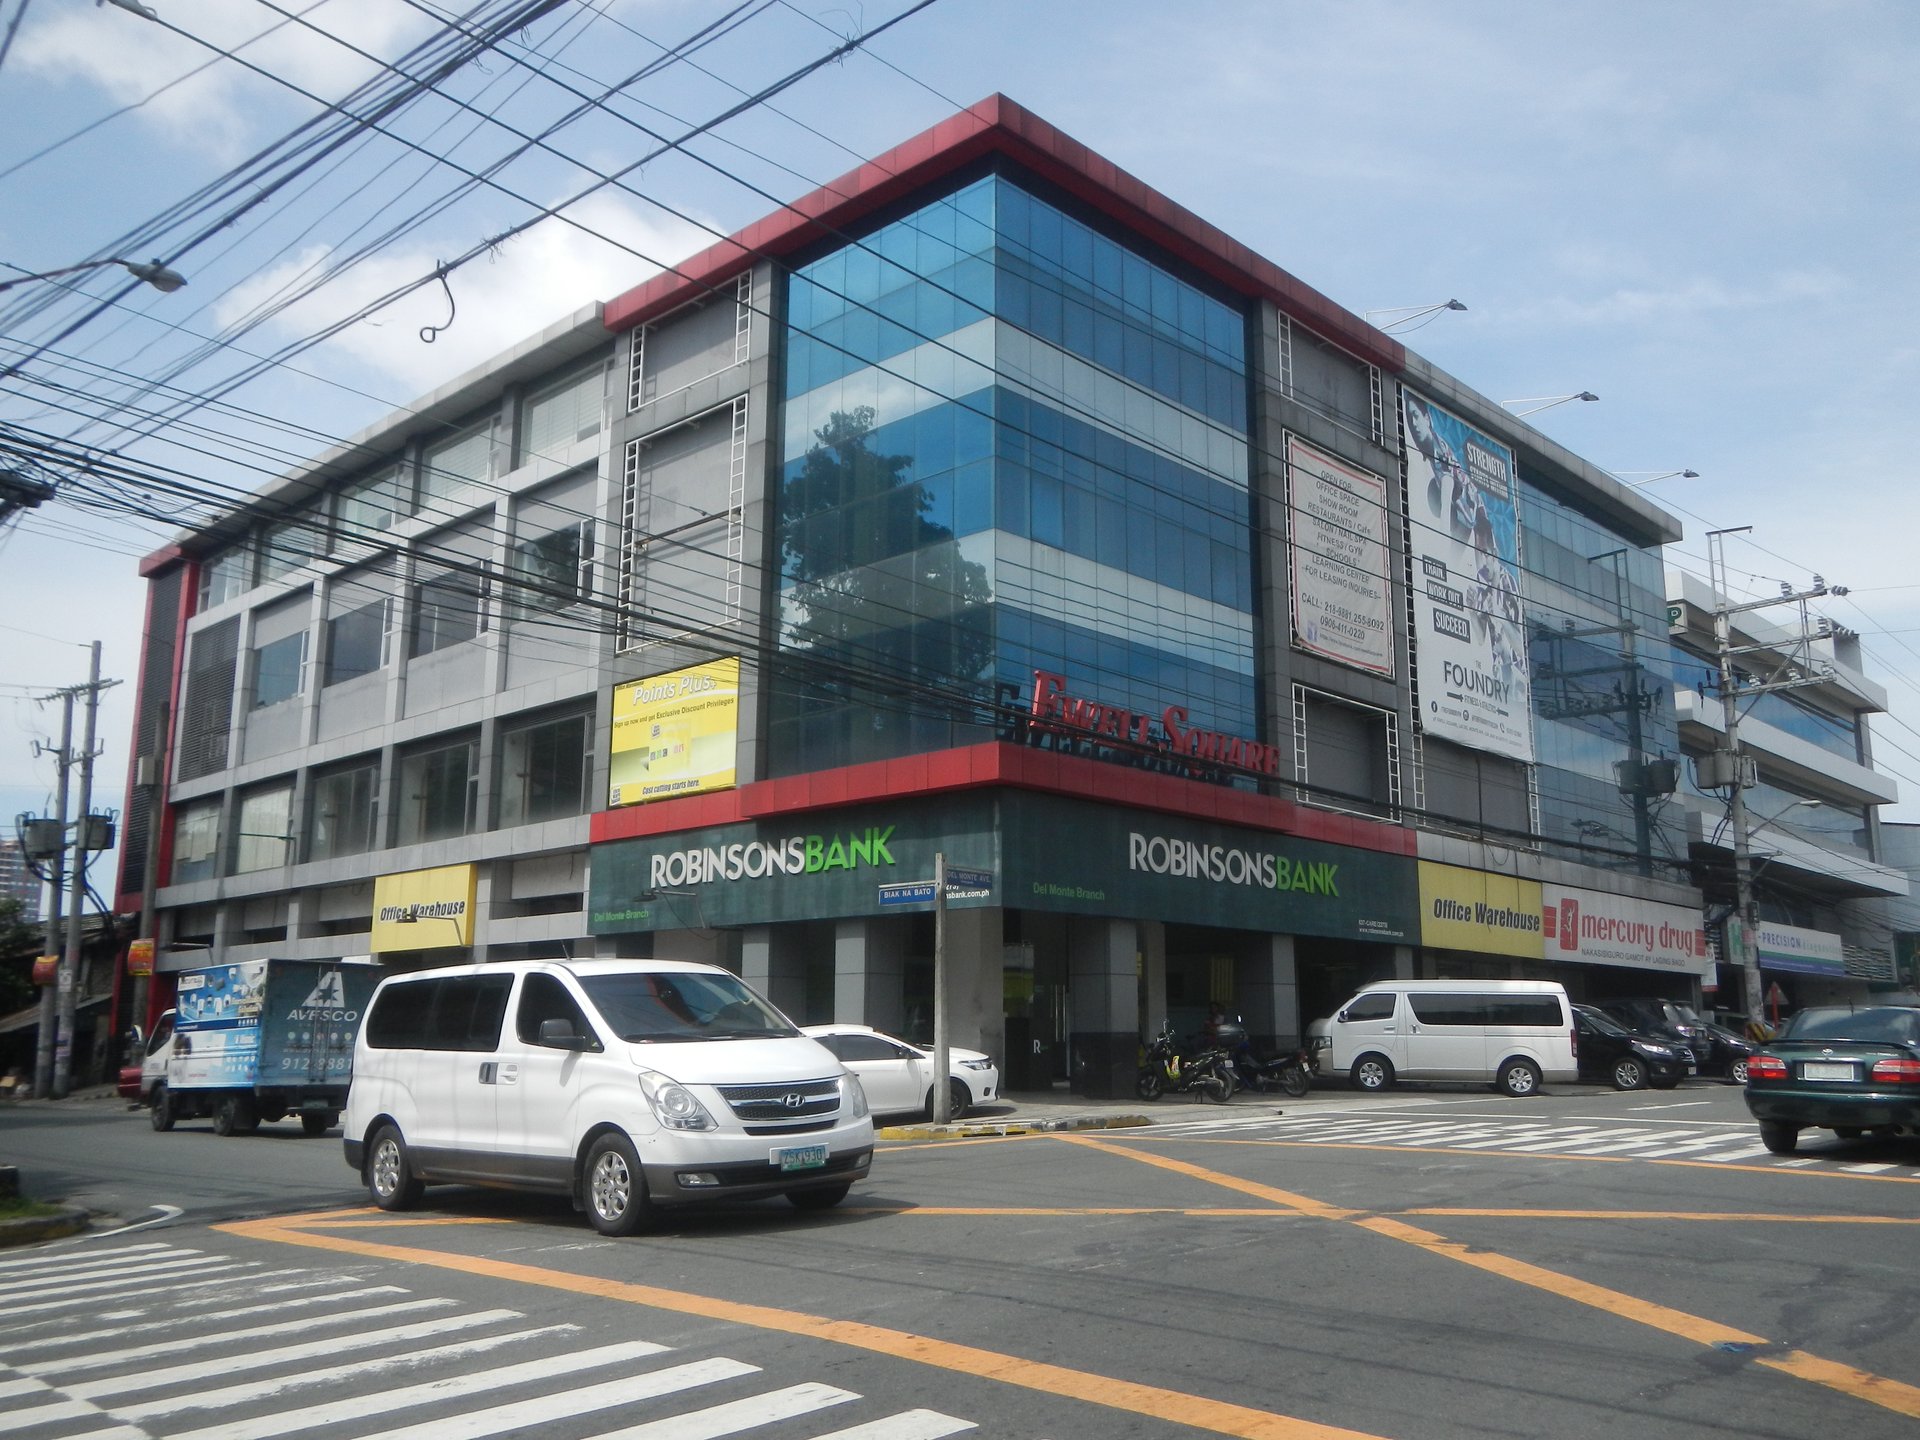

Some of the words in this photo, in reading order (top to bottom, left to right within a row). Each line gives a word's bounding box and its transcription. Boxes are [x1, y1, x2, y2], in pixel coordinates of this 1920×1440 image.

[1467, 442, 1507, 481] STRENGTH
[1320, 470, 1338, 486] OPEN
[1316, 481, 1339, 497] OFFICE
[1339, 490, 1360, 507] SPACE
[1307, 502, 1352, 528] RESTAURANTS
[1319, 495, 1337, 510] SHOW
[1339, 503, 1358, 518] ROOM
[1317, 532, 1344, 550] FITNESS
[1348, 544, 1363, 557] GYM
[1312, 555, 1345, 574] LEARNING
[1346, 567, 1370, 584] CENTER
[1319, 570, 1348, 589] LEASING
[1427, 582, 1448, 603] WORK
[1443, 660, 1510, 704] FOUNDRY
[633, 681, 675, 706] Points
[656, 709, 681, 719] Exclusive
[681, 703, 706, 714] Discount
[706, 697, 734, 709] Privileges
[671, 781, 687, 791] starts
[883, 890, 900, 899] BIAK
[902, 889, 912, 897] NA
[914, 887, 931, 896] BATO
[1033, 882, 1047, 895] Del
[1049, 884, 1075, 897] Monte
[1076, 887, 1105, 901] Branch
[380, 905, 408, 921] Office
[410, 900, 465, 917] Warehouse
[594, 912, 605, 922] Del
[605, 911, 625, 921] Monte
[625, 908, 649, 920] Branch
[1433, 898, 1471, 923] Office
[1474, 902, 1540, 933] Warehouse
[1581, 914, 1654, 952] mercury
[1659, 920, 1693, 957] drug
[287, 1009, 358, 1022] AVESCO
[281, 1057, 310, 1070] 912
